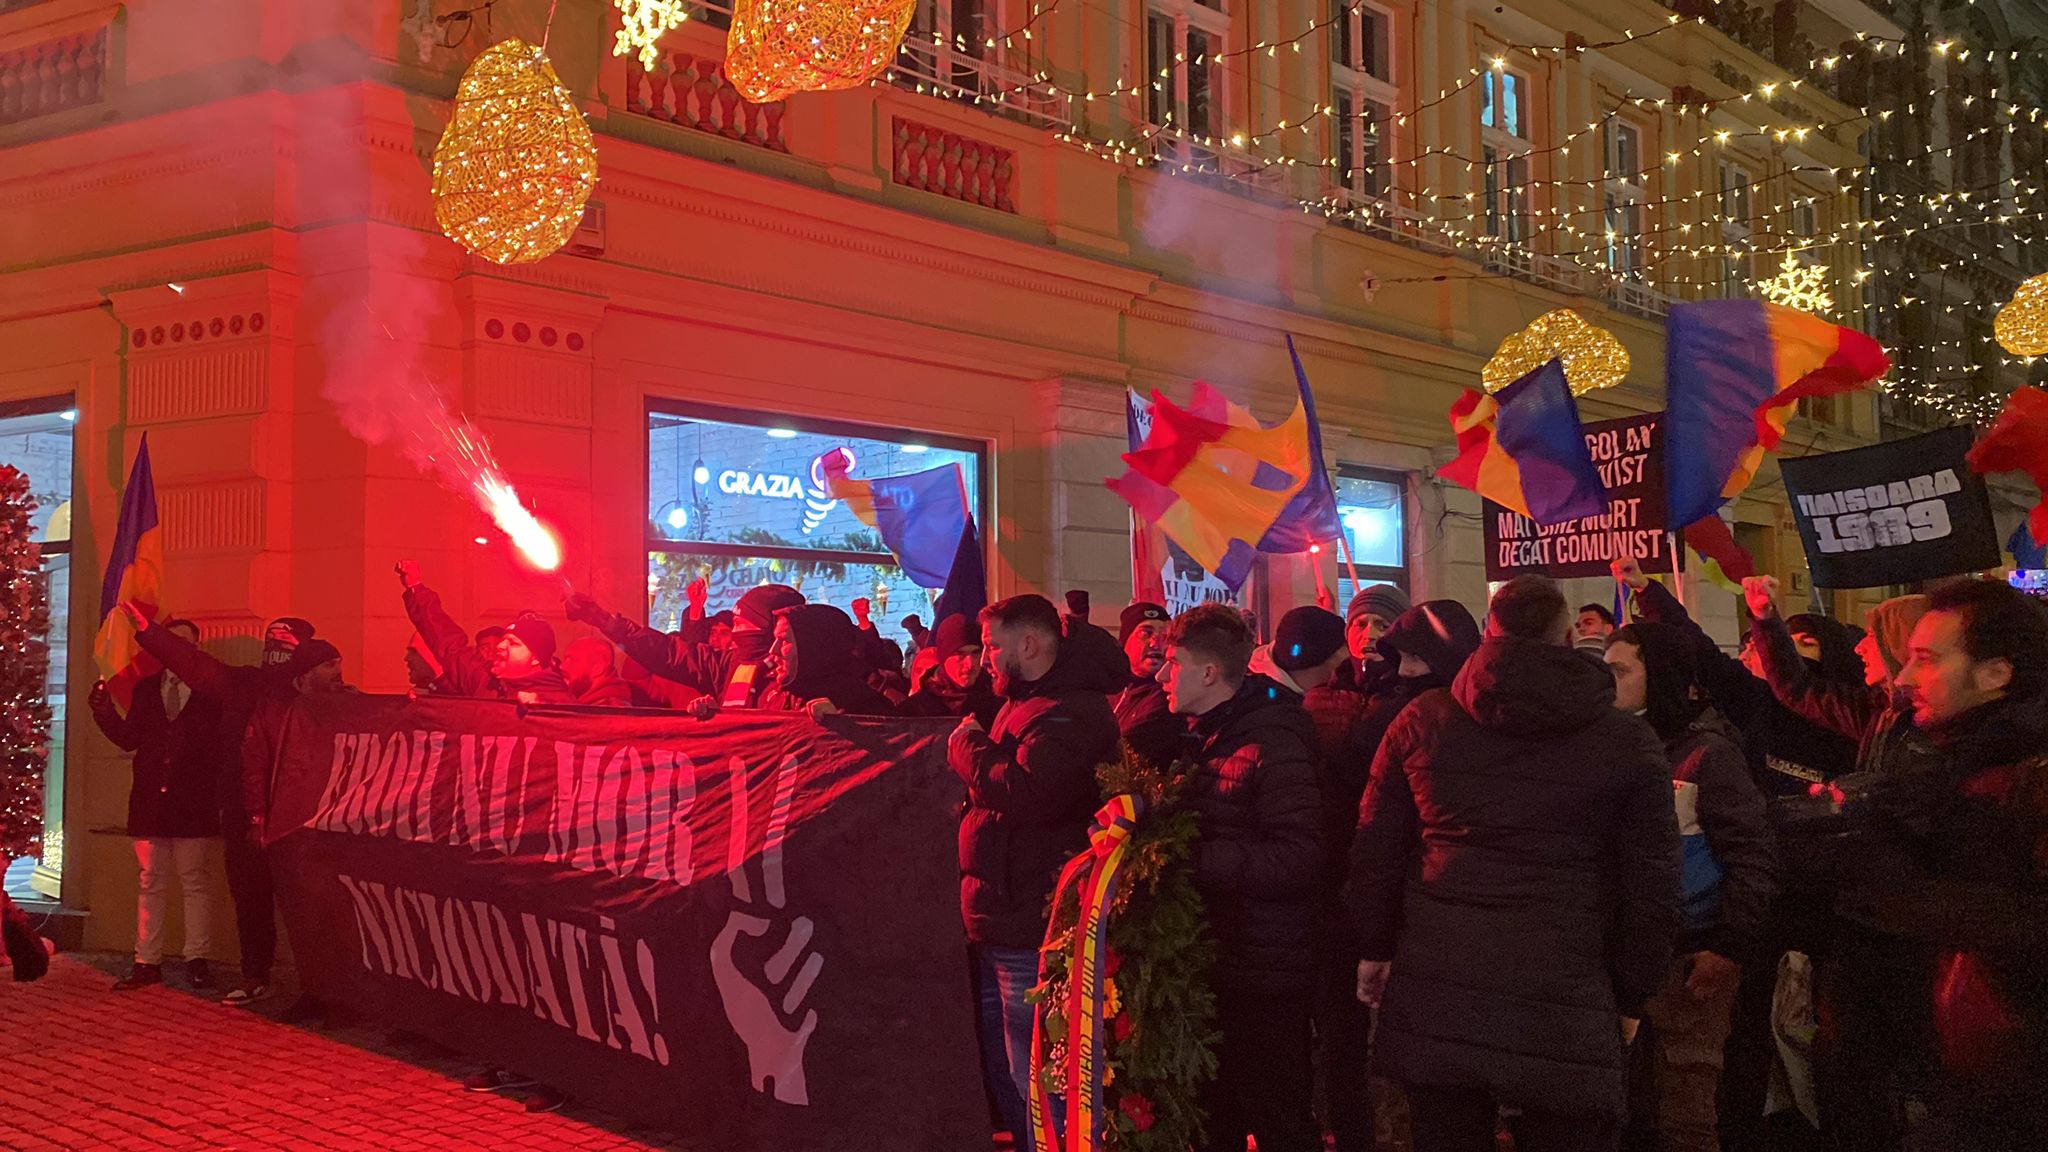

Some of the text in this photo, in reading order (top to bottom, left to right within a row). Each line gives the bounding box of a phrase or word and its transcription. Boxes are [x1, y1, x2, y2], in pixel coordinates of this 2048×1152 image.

[718, 470, 804, 499] GRAZIA
[1597, 453, 1648, 489] VIST
[1797, 468, 1961, 516] TIMISOARA
[1498, 512, 1532, 539] MAI
[1581, 498, 1641, 532] MORT
[1812, 499, 1952, 553] 1989
[1499, 529, 1663, 568] DECAT COMUNIST
[303, 730, 697, 886] EROII NU MOR
[1079, 1034, 1093, 1114] COMPLICE
